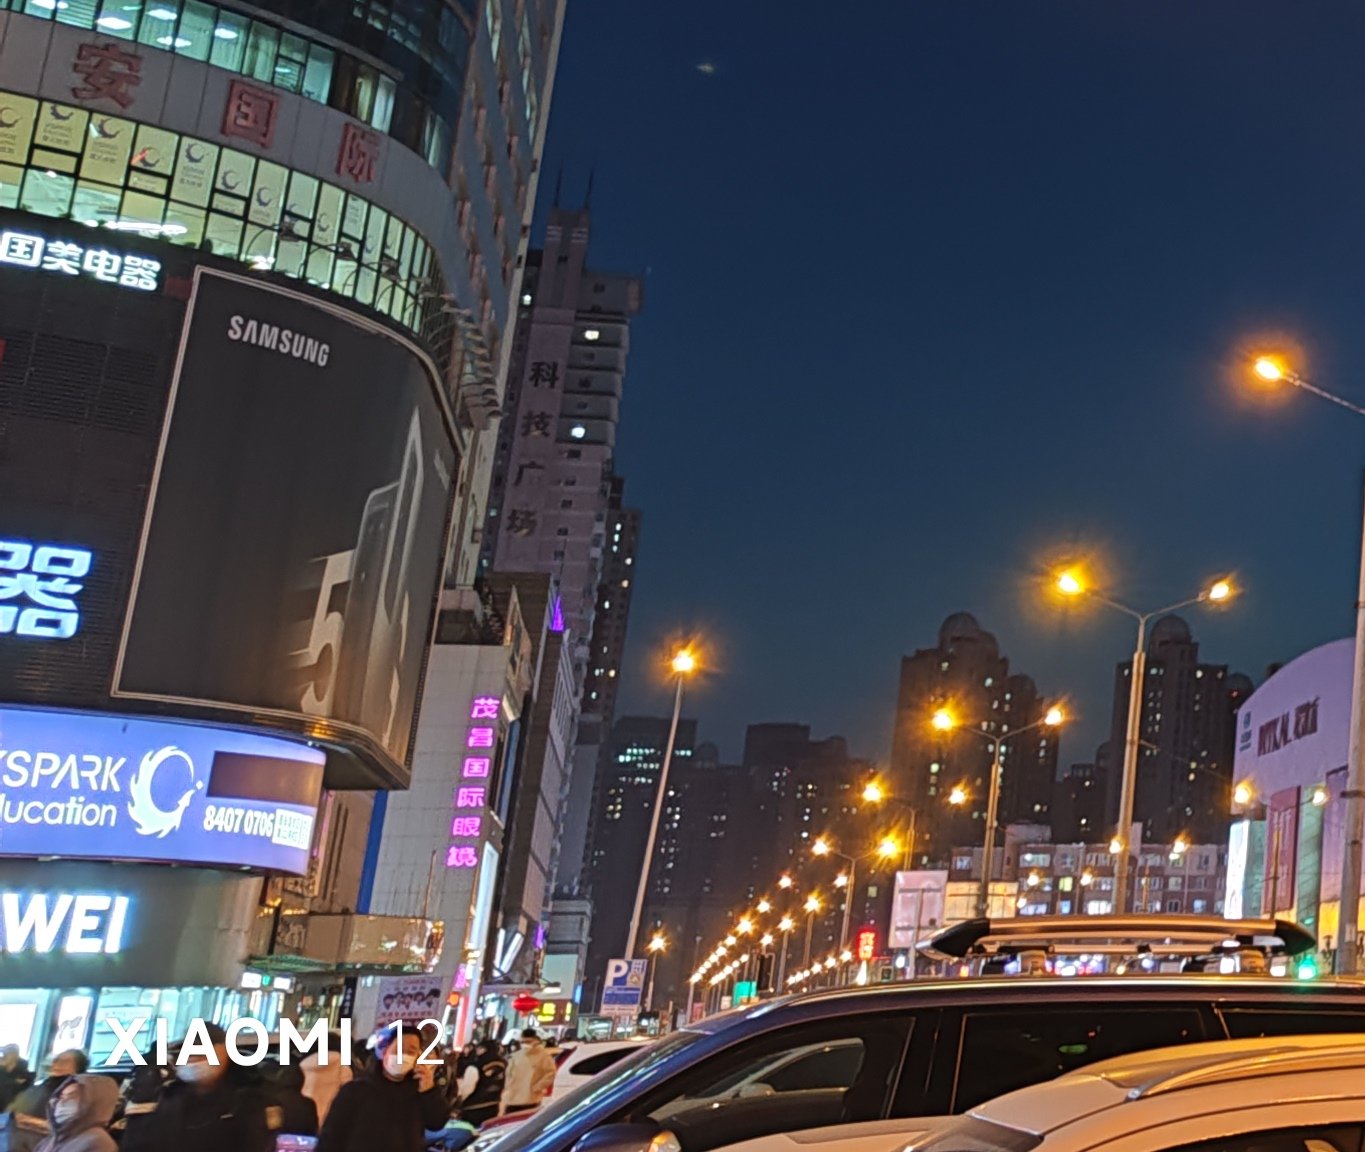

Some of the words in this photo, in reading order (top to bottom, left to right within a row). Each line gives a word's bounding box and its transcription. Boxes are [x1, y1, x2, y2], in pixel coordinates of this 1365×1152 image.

[0, 231, 162, 292] 国美电器
[227, 314, 330, 367] SAMSUNG
[507, 361, 560, 538] 科技广场
[0, 750, 127, 792] SPARK
[446, 697, 500, 868] 茂昌国际眼镜
[203, 805, 244, 834] 8407
[243, 810, 275, 838] 0706
[2, 893, 130, 953] WEI
